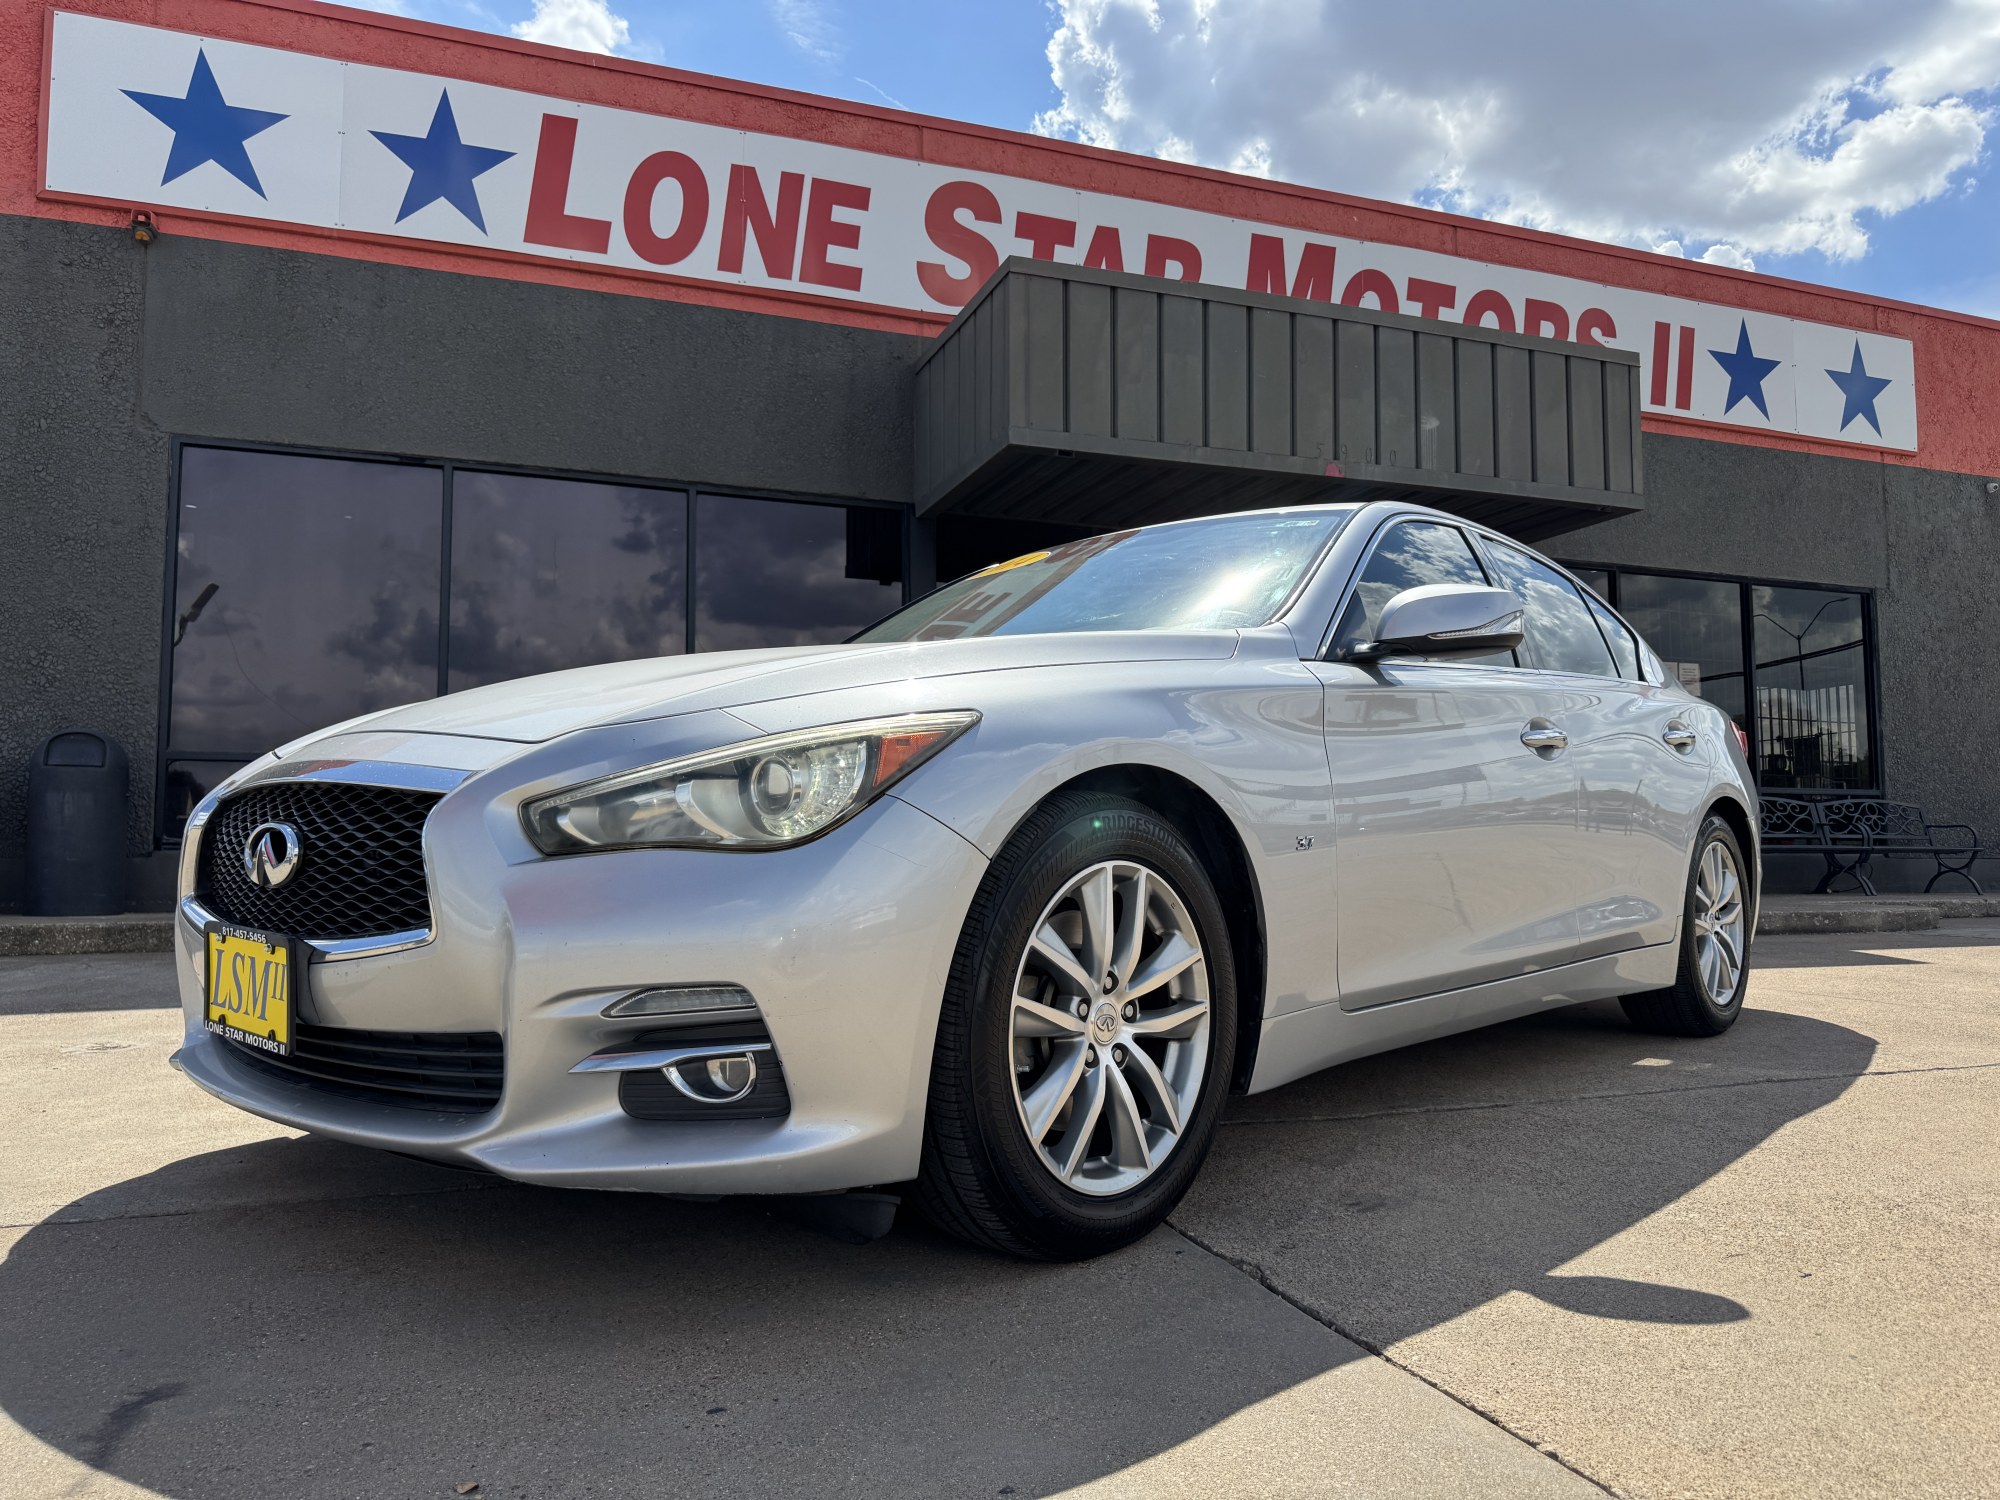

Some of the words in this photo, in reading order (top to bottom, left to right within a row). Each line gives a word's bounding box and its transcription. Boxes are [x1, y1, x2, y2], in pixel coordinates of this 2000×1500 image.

[523, 113, 871, 292] LONE
[222, 926, 267, 943] 817-457-5456
[204, 1020, 224, 1035] LONE
[225, 1027, 244, 1041] STAR
[245, 1033, 279, 1053] MOTORS
